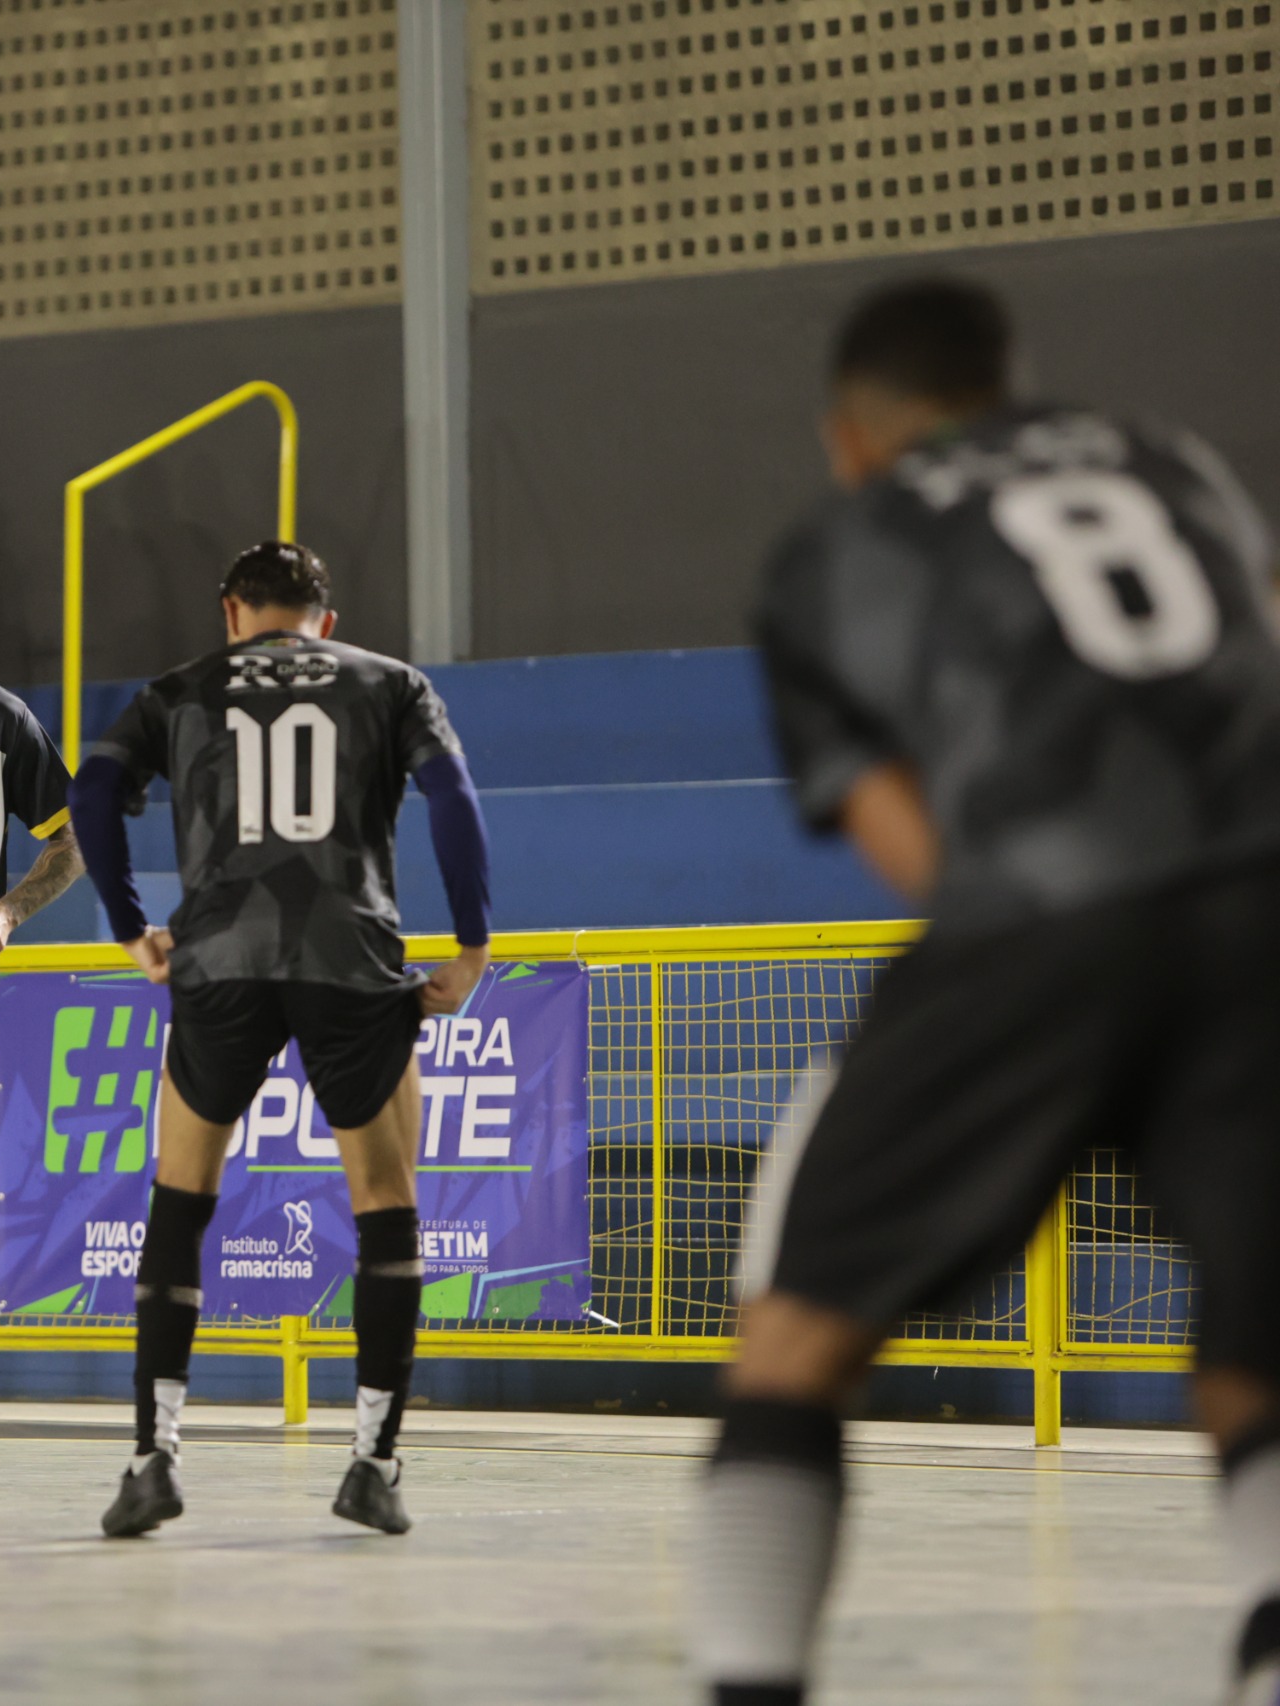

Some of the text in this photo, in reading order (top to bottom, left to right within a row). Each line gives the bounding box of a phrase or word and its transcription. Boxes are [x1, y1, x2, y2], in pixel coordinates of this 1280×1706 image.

[988, 468, 1220, 680] 8
[226, 703, 337, 844] 10
[413, 1017, 514, 1067] PIRA
[85, 1221, 146, 1249] VIVA O
[417, 1220, 487, 1230] EFEITURA DE
[221, 1235, 279, 1254] instituto
[221, 1254, 312, 1278] ramacrisna
[440, 1264, 460, 1273] PARA
[461, 1264, 489, 1274] TODOS
